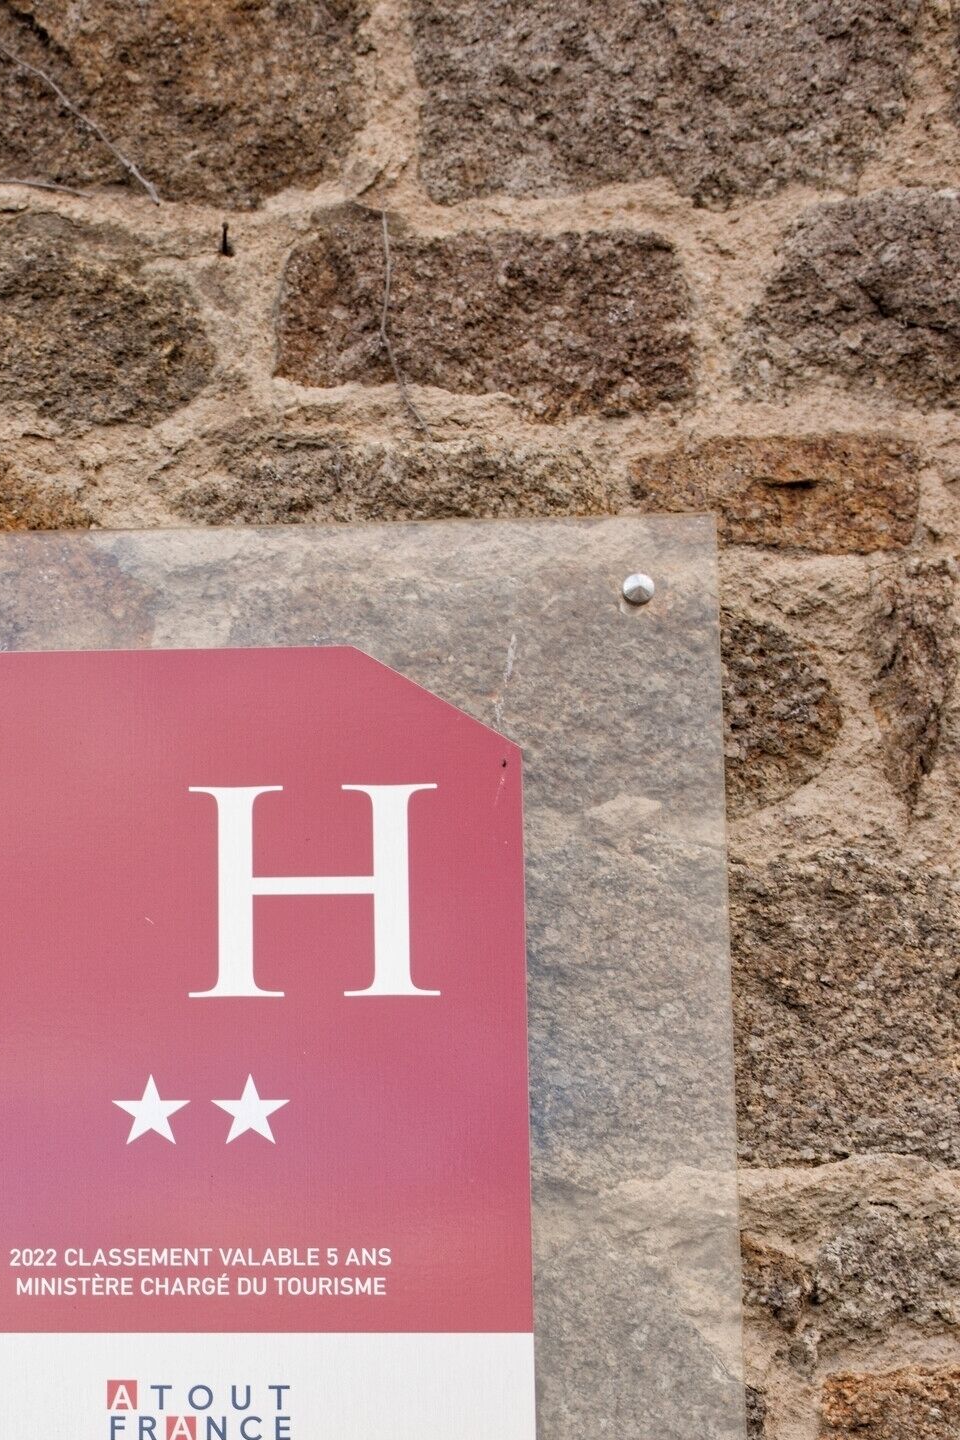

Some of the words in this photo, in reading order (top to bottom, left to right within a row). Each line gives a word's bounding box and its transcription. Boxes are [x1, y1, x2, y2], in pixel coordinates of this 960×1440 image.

[188, 783, 441, 998] H
[9, 1248, 57, 1267] 2022
[64, 1248, 213, 1267] CLASSEMENT
[219, 1248, 320, 1266] VALABLE
[326, 1248, 338, 1266] 5
[345, 1247, 392, 1266] ANS
[16, 1274, 134, 1296] MINISTÈRE
[140, 1274, 230, 1296] CHARGÉ
[237, 1277, 268, 1296] DU
[274, 1276, 387, 1295] TOURISME
[109, 1383, 291, 1411] ATOUT
